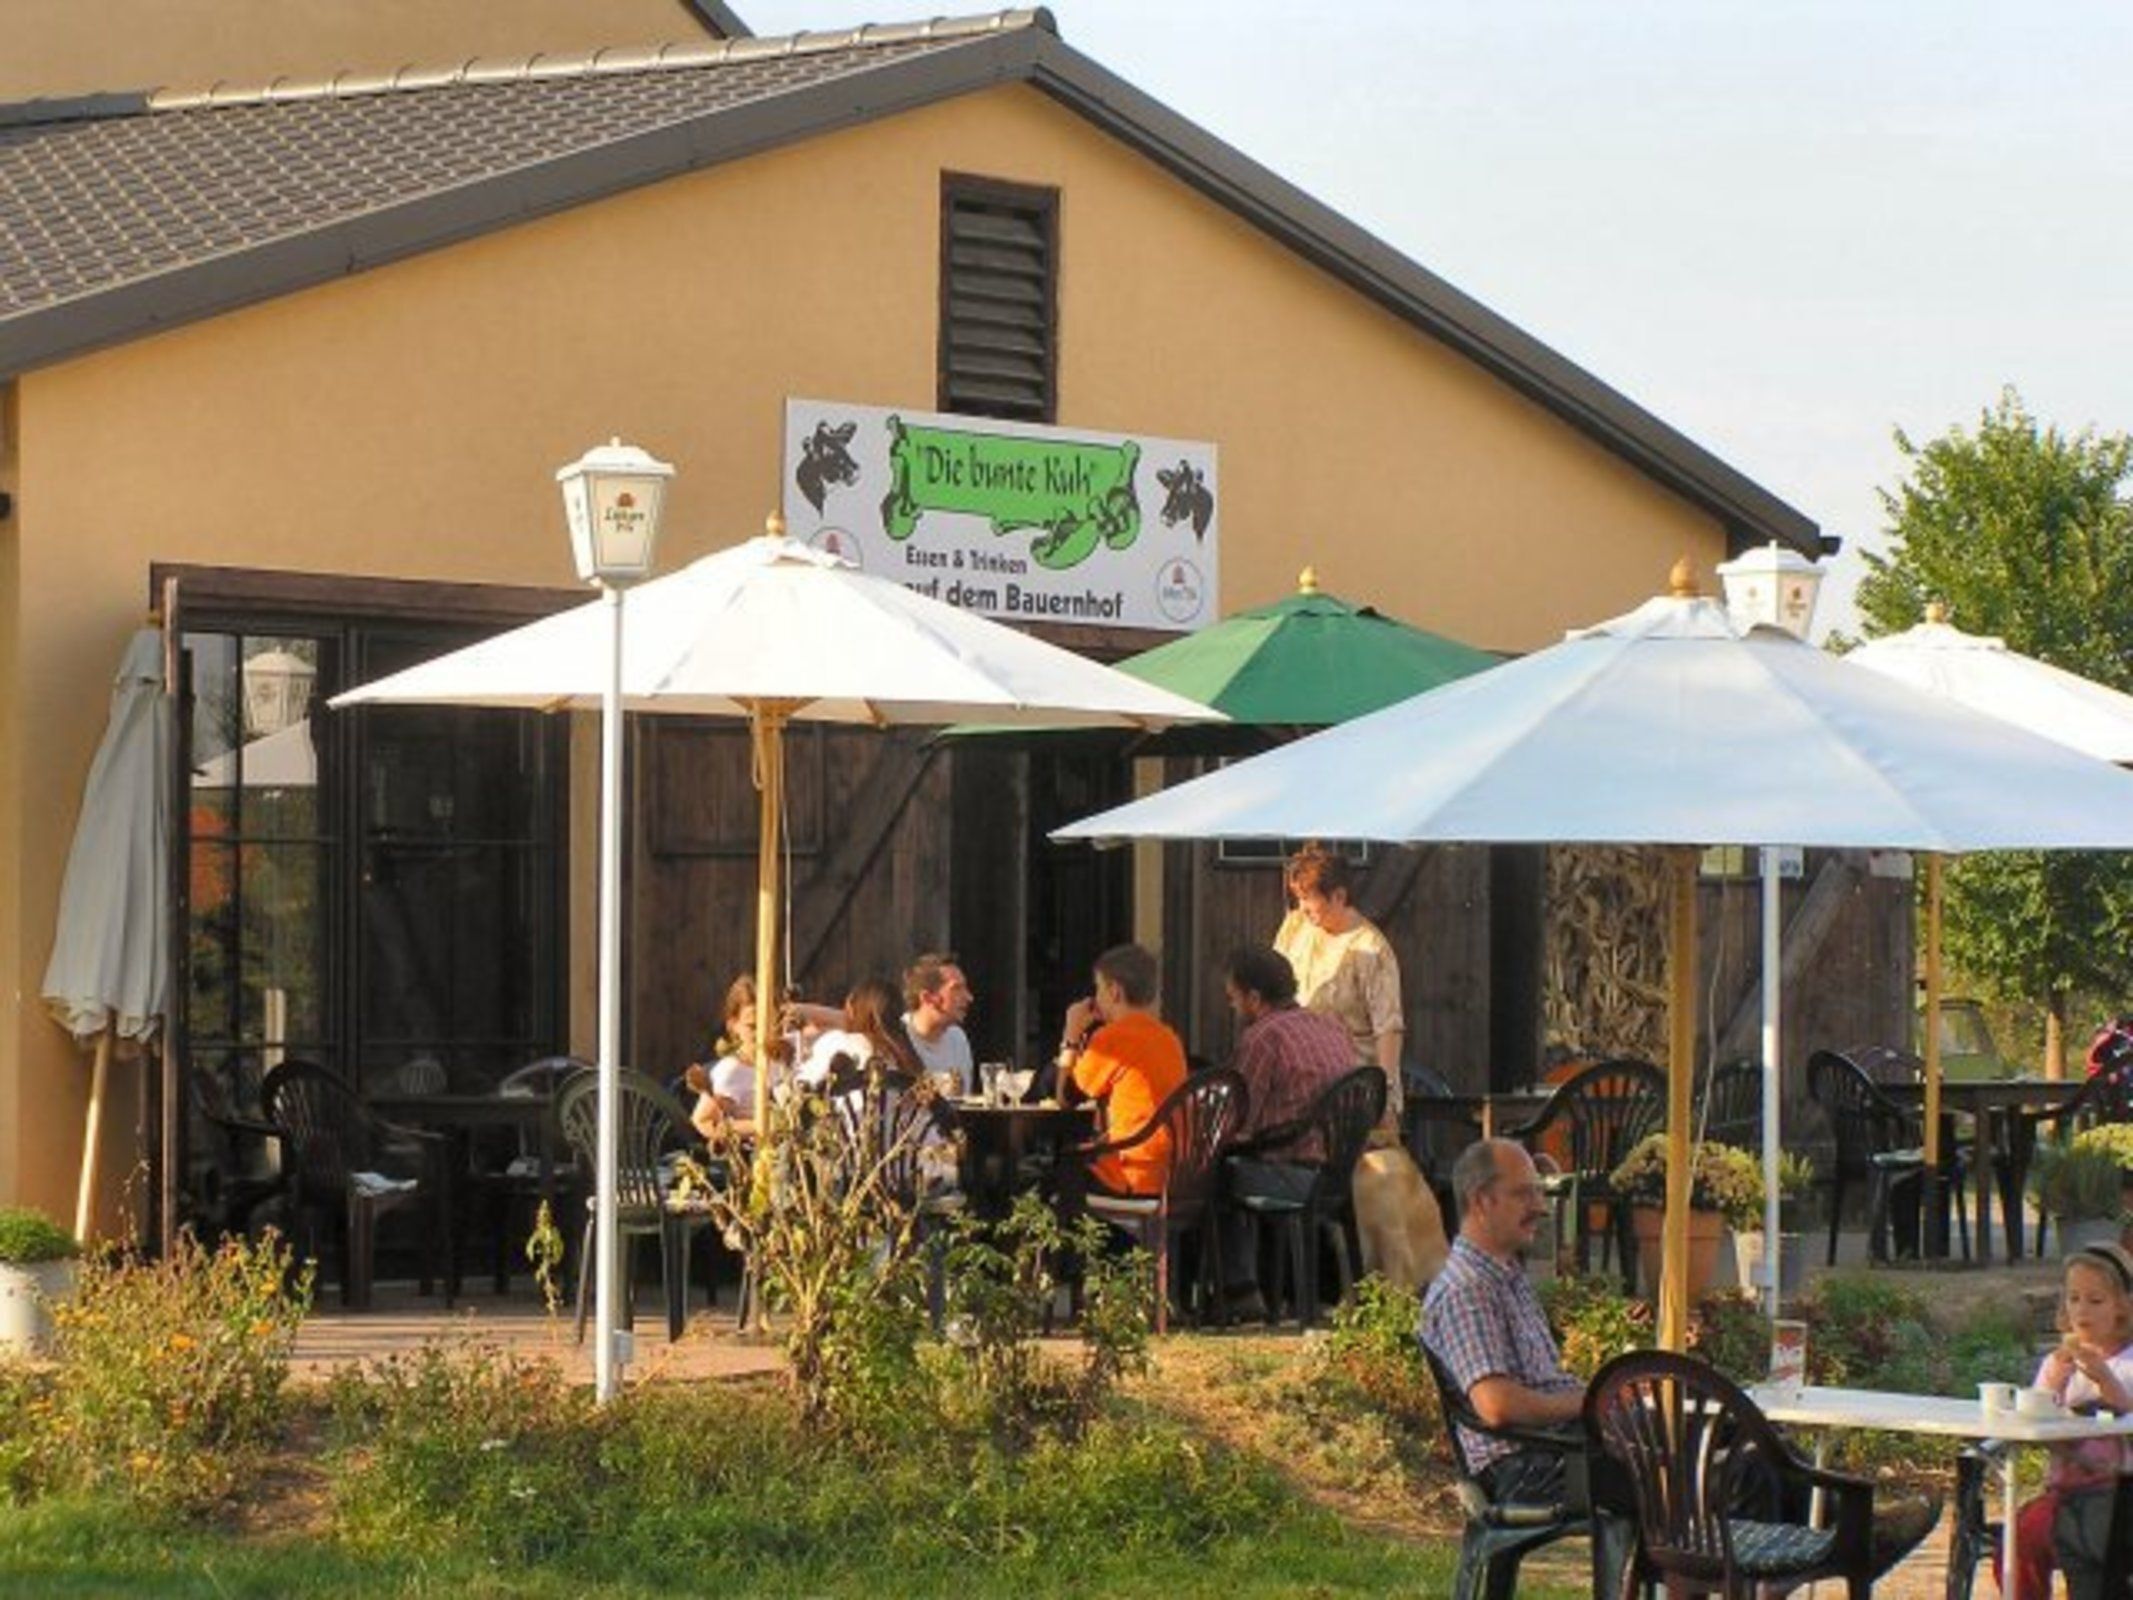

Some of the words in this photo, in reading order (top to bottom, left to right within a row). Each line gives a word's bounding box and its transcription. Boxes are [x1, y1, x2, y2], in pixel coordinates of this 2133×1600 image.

[969, 445, 1036, 493] bunte
[905, 545, 948, 567] Essen
[953, 551, 964, 568] &
[969, 550, 1027, 574] Trinken
[946, 580, 998, 611] dem
[1006, 584, 1124, 618] Bauernhof
